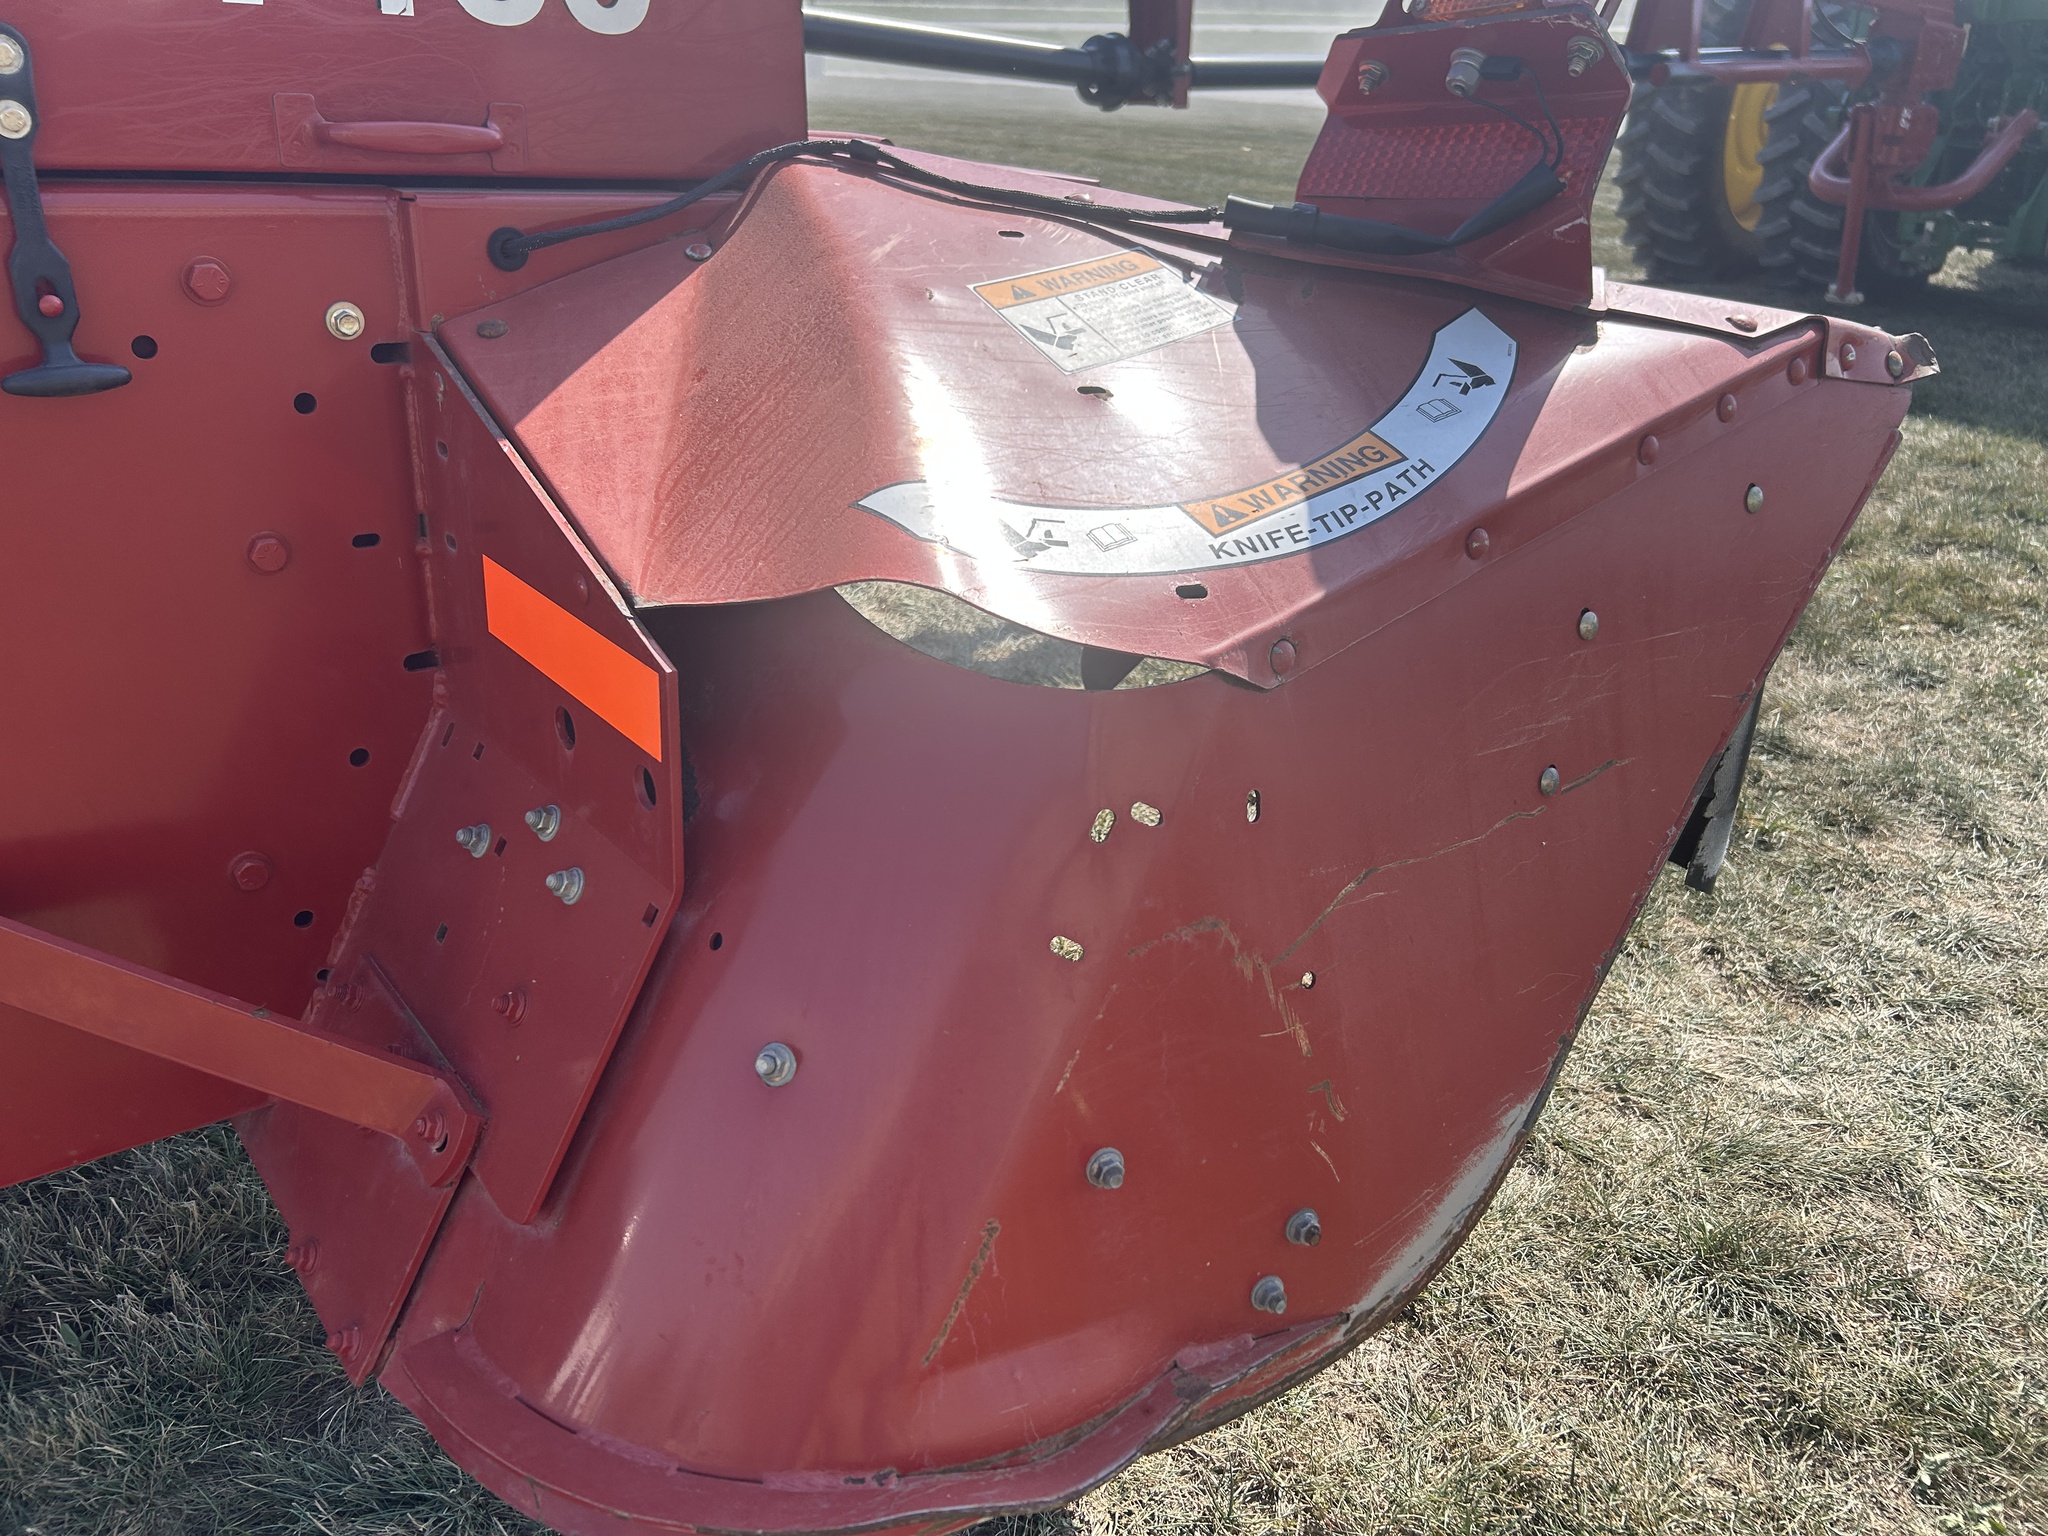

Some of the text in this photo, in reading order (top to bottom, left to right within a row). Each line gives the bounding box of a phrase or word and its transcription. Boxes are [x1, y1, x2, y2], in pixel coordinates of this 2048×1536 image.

[1037, 258, 1139, 292] WARNING
[1074, 273, 1161, 302] STAND CLEAR
[1241, 445, 1390, 513] WARNING
[1208, 457, 1436, 559] KNIFE-TIP-PATH
